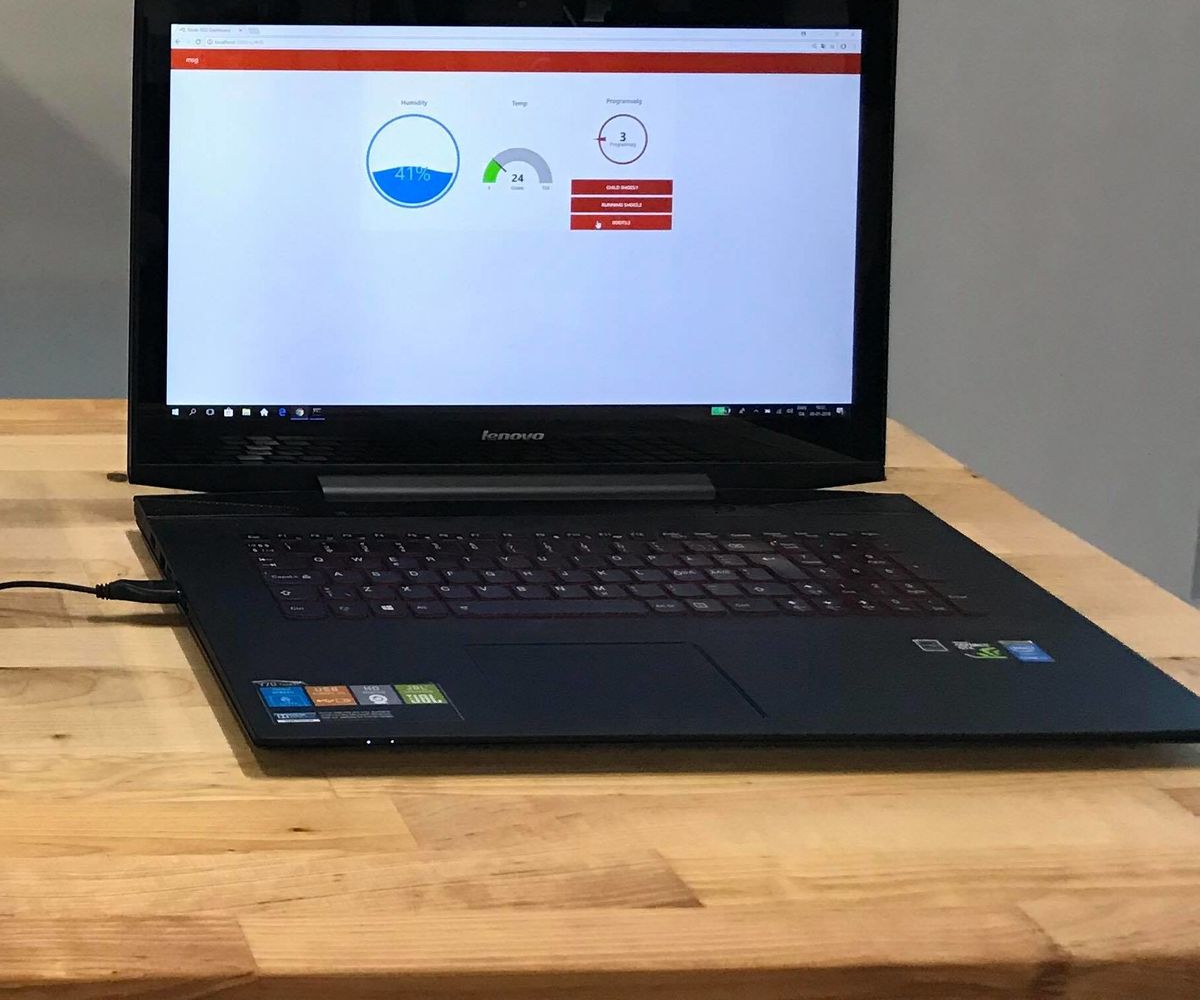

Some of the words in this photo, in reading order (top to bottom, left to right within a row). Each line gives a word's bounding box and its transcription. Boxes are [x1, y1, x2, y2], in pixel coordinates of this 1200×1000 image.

[400, 99, 428, 107] Humidity
[619, 131, 627, 142] 3
[394, 166, 431, 181] 41%
[511, 173, 524, 183] 24
[481, 430, 545, 441] lenovo
